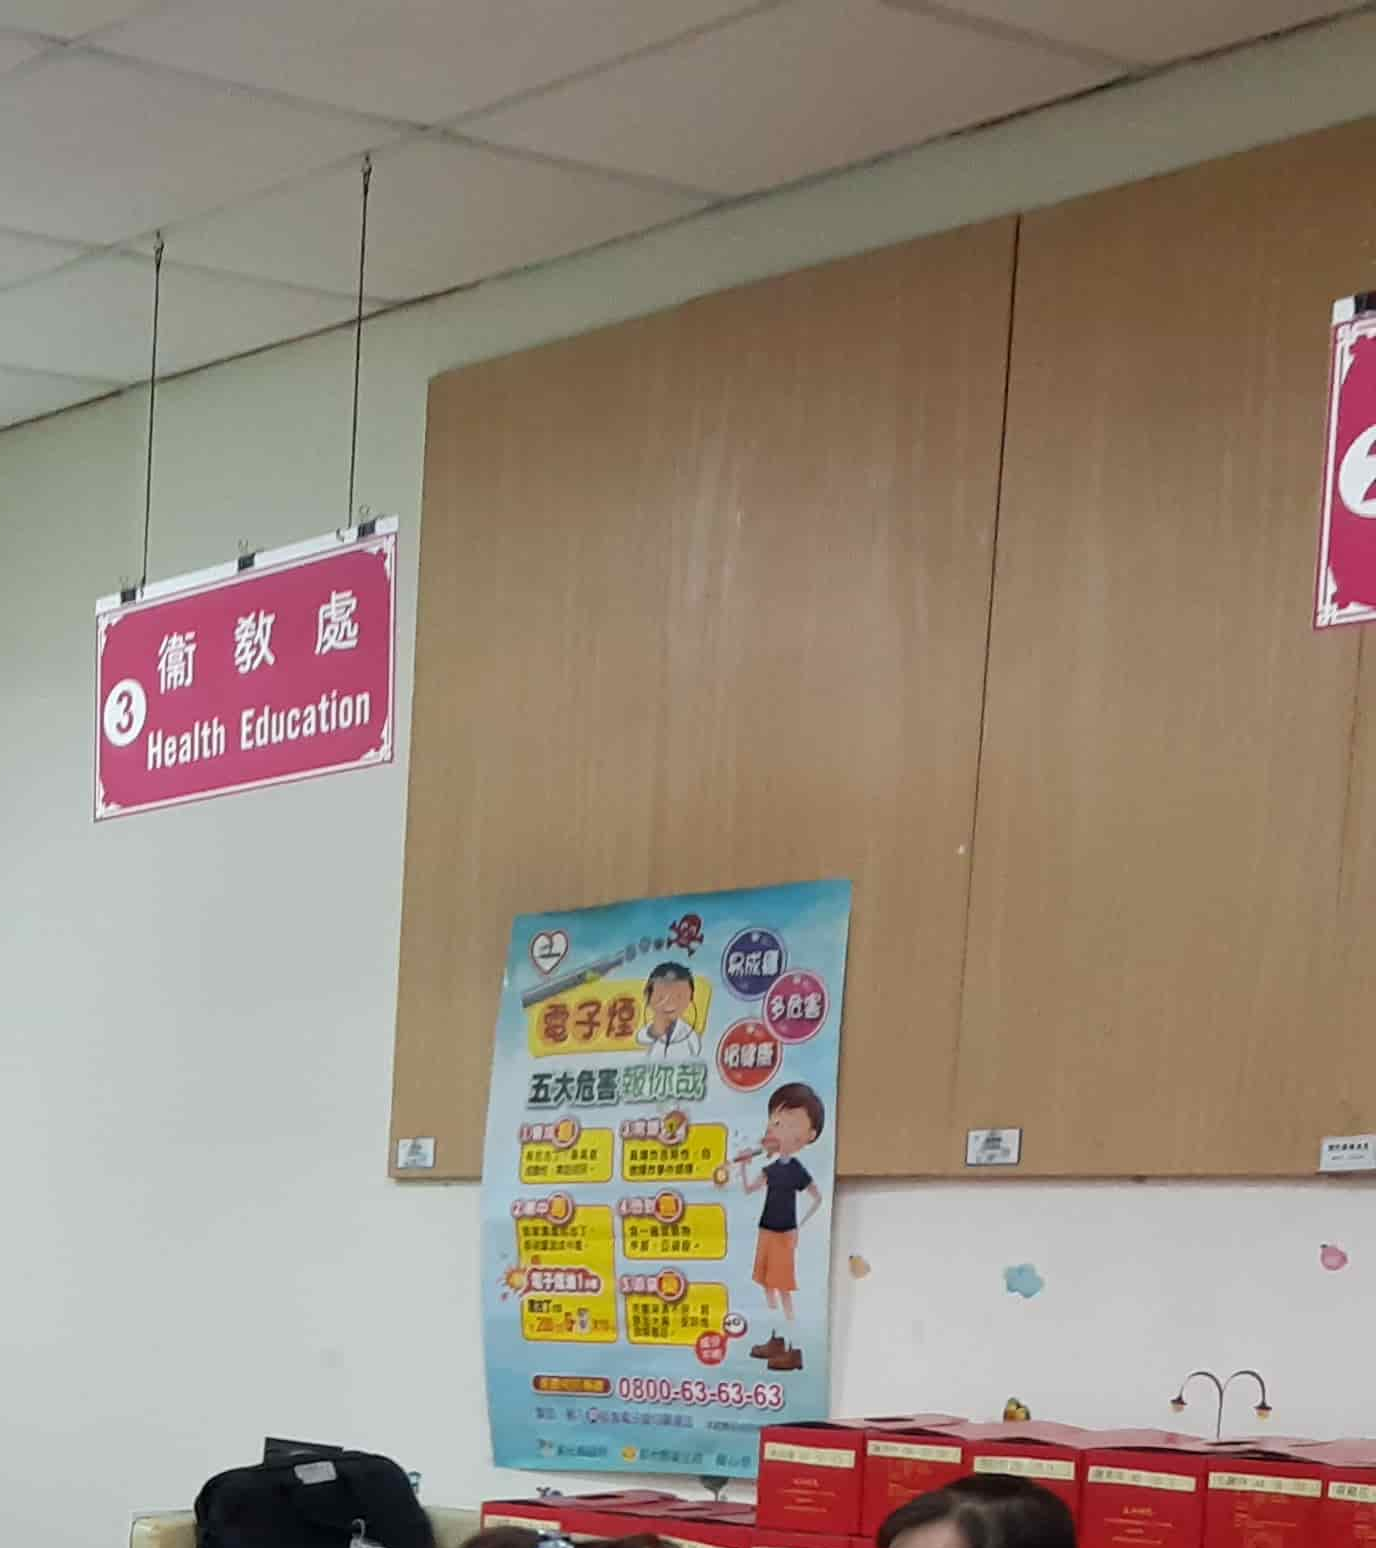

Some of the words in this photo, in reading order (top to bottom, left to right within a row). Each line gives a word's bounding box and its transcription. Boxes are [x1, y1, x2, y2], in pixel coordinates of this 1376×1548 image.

[114, 690, 136, 733] 3
[147, 716, 226, 771] Health
[240, 690, 371, 751] Education
[541, 995, 637, 1044] 電子煙
[618, 1377, 783, 1408] 0800-63-63-63
